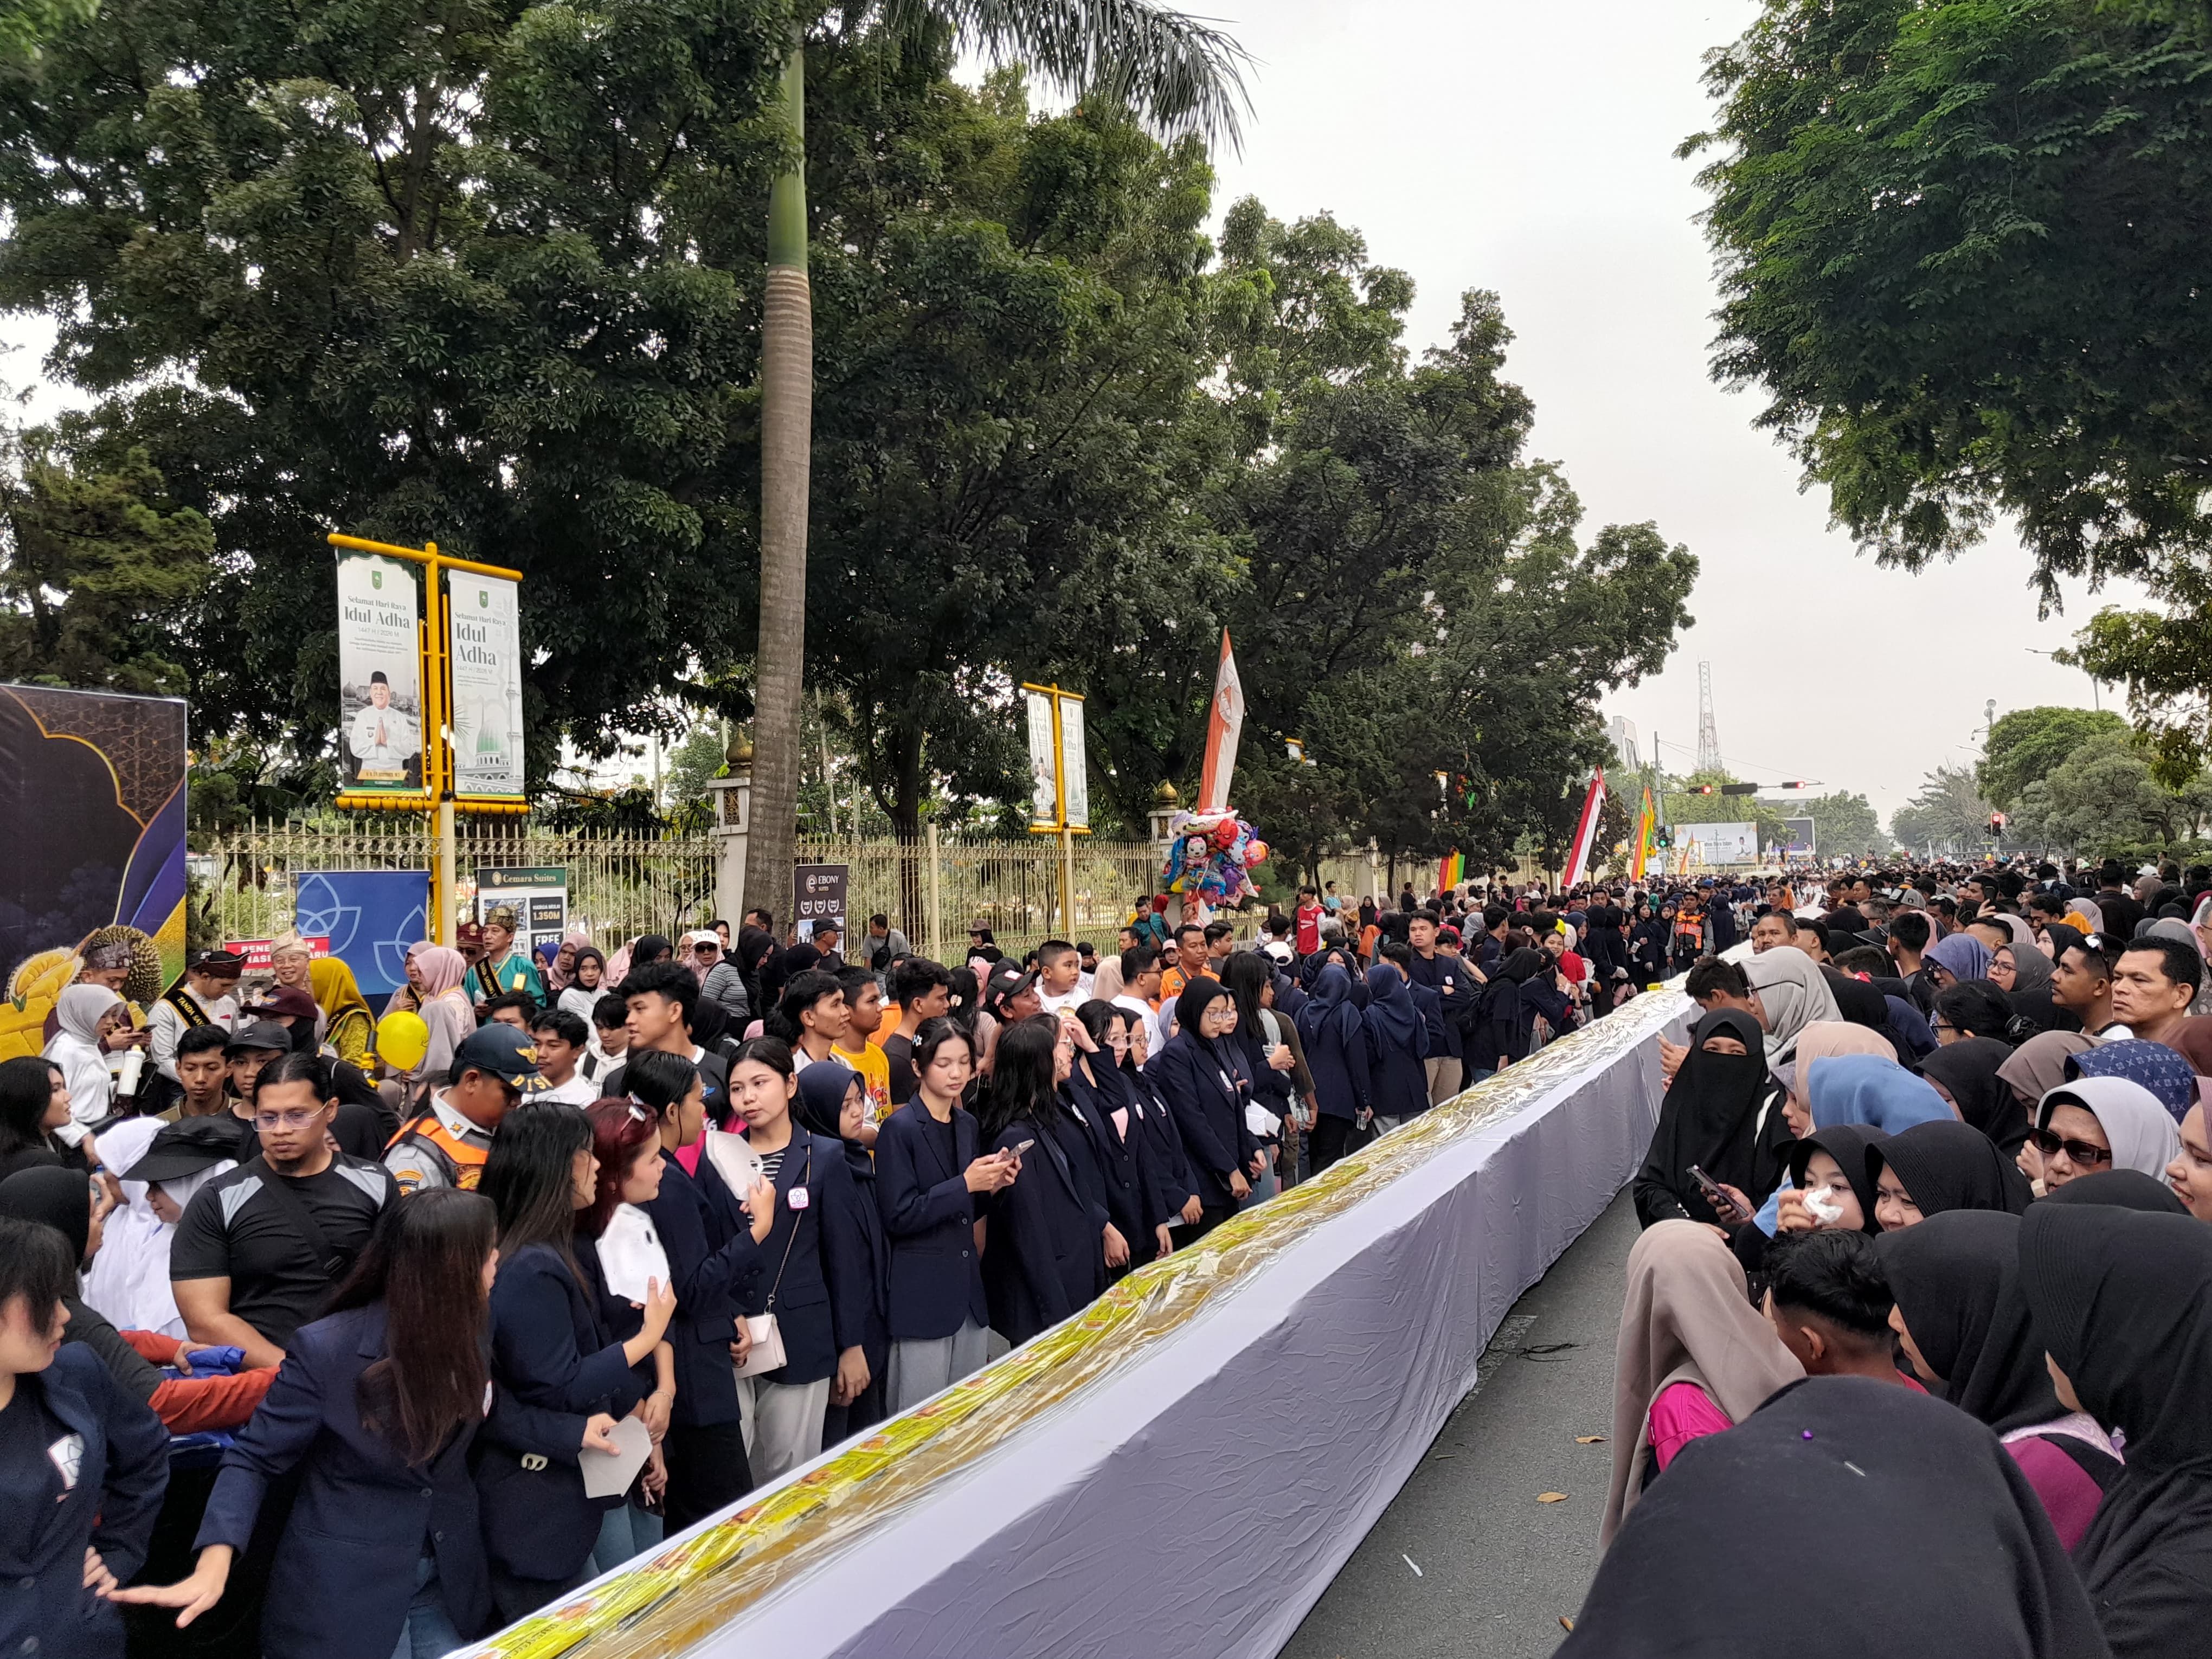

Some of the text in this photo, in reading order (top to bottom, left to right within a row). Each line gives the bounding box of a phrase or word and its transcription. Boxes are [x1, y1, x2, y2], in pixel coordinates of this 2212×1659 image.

[348, 595, 406, 612] Selamat Hari Raya
[344, 606, 410, 629] Idul Adha
[455, 612, 478, 621] Selamat
[492, 618, 506, 626] Raya
[456, 623, 486, 642] Idul
[455, 645, 497, 665] Adha
[503, 873, 556, 883] Cemara Suites
[818, 874, 839, 884] EBONY
[533, 911, 560, 921] 1.350M
[308, 950, 329, 959] ARU
[177, 996, 196, 1016] TANDA
